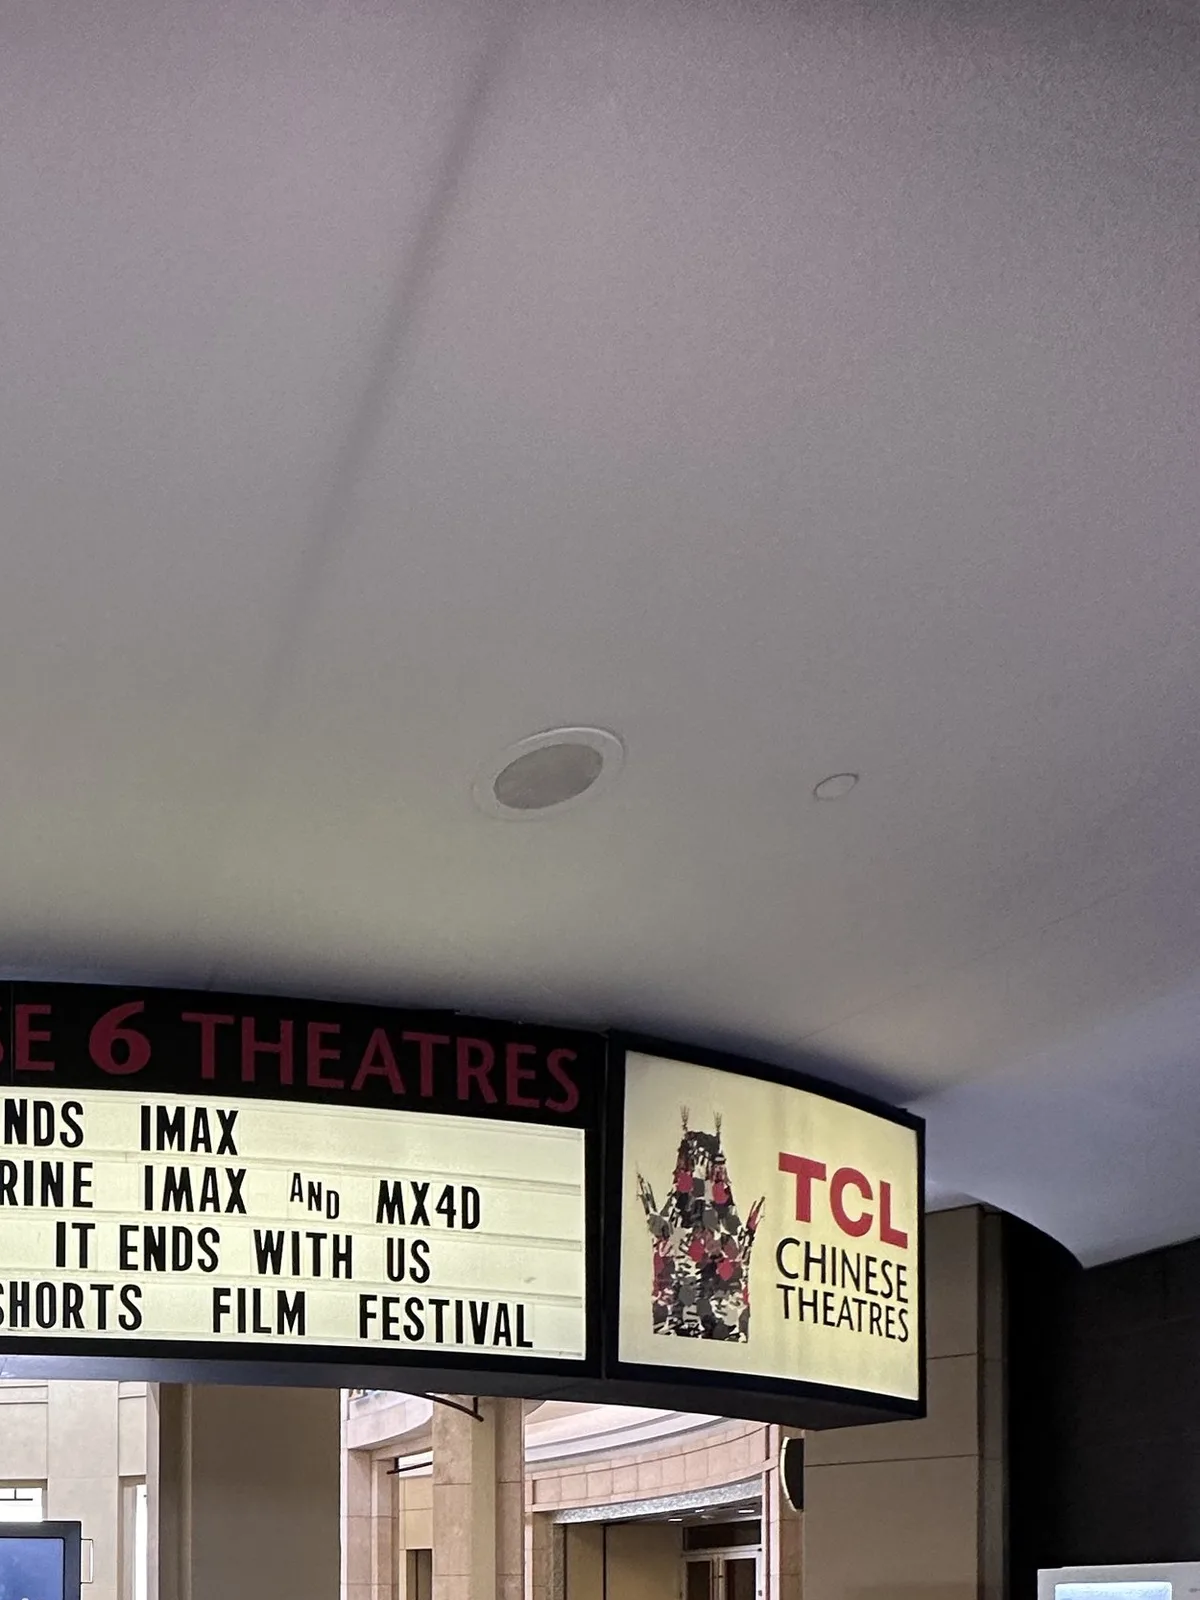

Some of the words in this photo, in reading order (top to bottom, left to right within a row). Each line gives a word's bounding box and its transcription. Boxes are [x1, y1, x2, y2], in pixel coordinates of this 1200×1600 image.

[89, 1001, 151, 1074] 6
[182, 1012, 579, 1112] THEATRES
[140, 1104, 239, 1156] IMAX
[144, 1164, 247, 1215] IMAX
[289, 1172, 340, 1220] AND
[376, 1179, 481, 1230] MX4D
[777, 1151, 909, 1250] TCL
[55, 1221, 96, 1269] IT
[119, 1224, 220, 1273] ENDS
[253, 1229, 353, 1280] WITH
[386, 1237, 431, 1284] US
[775, 1237, 910, 1304] CHINESE
[212, 1287, 306, 1336] FILM
[359, 1293, 533, 1349] FESTIVAL
[776, 1283, 910, 1344] THEATRES
